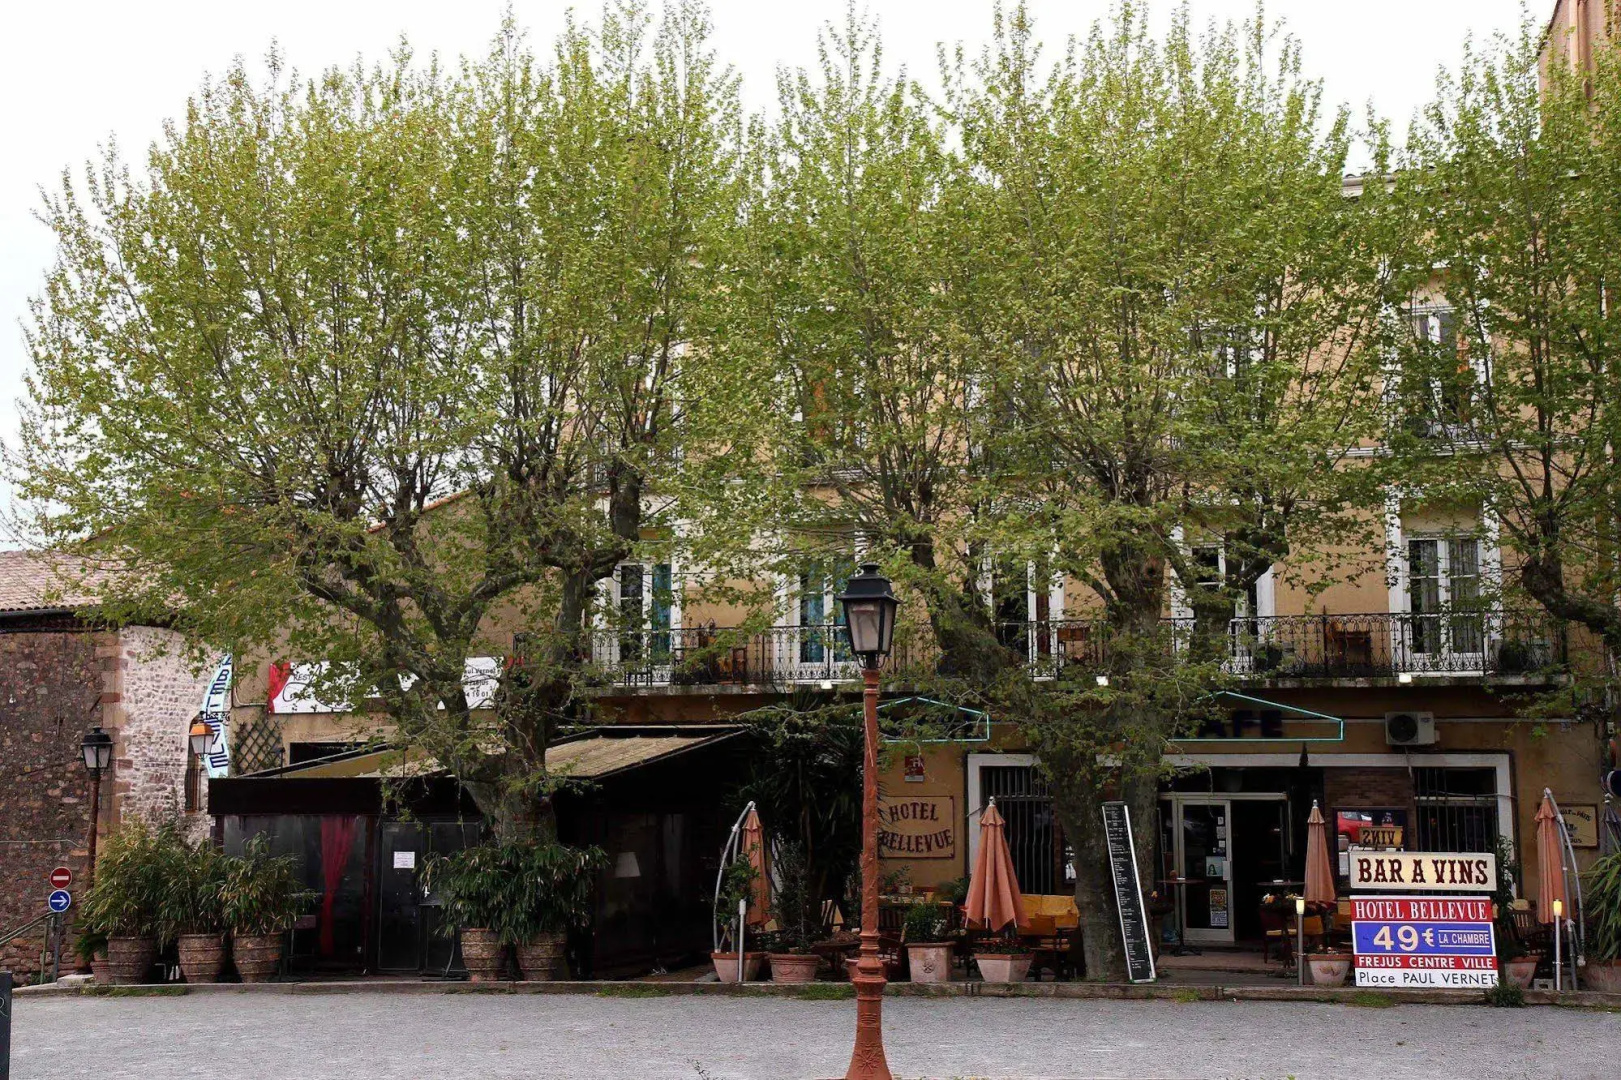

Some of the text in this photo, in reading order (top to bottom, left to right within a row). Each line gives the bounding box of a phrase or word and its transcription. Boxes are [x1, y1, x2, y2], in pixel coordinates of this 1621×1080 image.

[1176, 709, 1284, 738] AFE
[888, 802, 939, 821] HOTEL
[880, 828, 954, 853] BELLEVUE
[1357, 858, 1488, 885] BAR A VINS
[1355, 901, 1488, 920] HOTEL BELLEVUE
[1438, 933, 1490, 944] LA CHAMBRE
[1359, 956, 1493, 969] FREJUS CENTRE VILLE
[1359, 971, 1496, 985] Place PAUL VERNET
